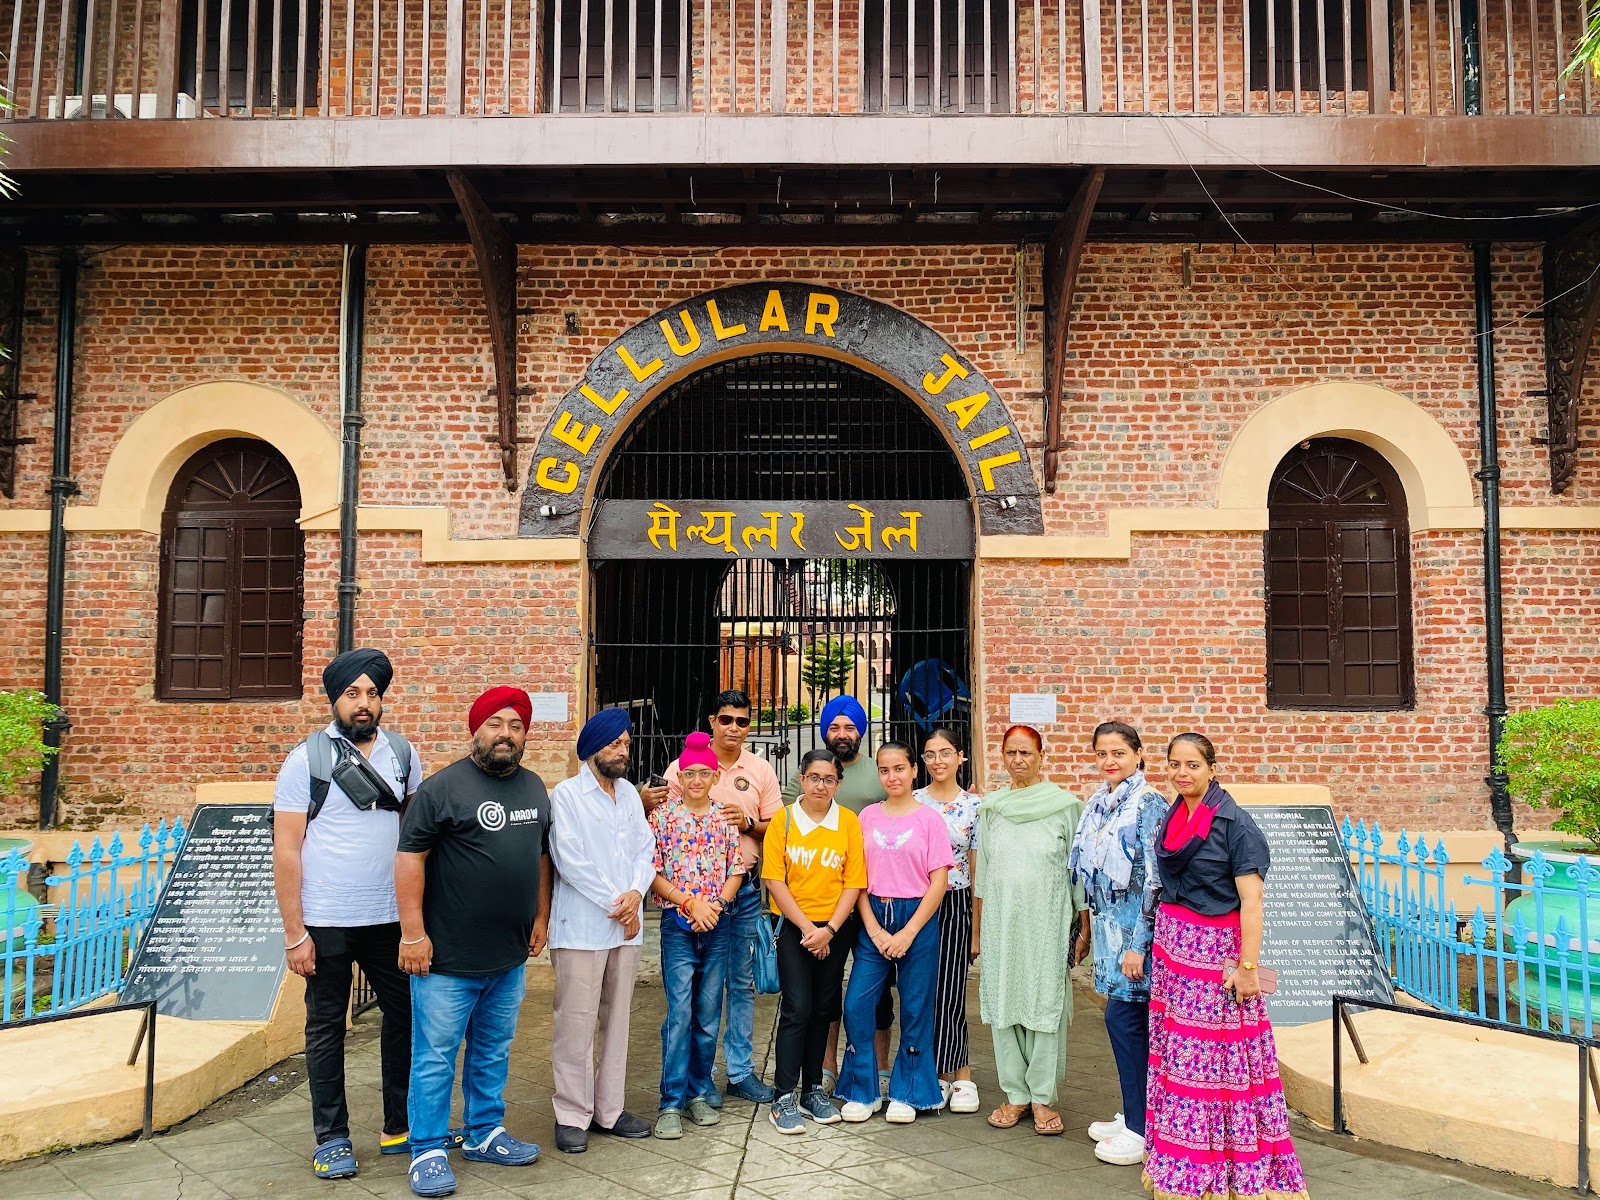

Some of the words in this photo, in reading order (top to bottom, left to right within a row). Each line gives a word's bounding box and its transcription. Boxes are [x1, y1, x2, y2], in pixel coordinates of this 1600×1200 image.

[536, 289, 840, 494] CELLULAR
[922, 352, 1022, 492] JAIL
[834, 503, 923, 553] जेल
[510, 808, 538, 821] ARROW
[786, 845, 818, 871] Why
